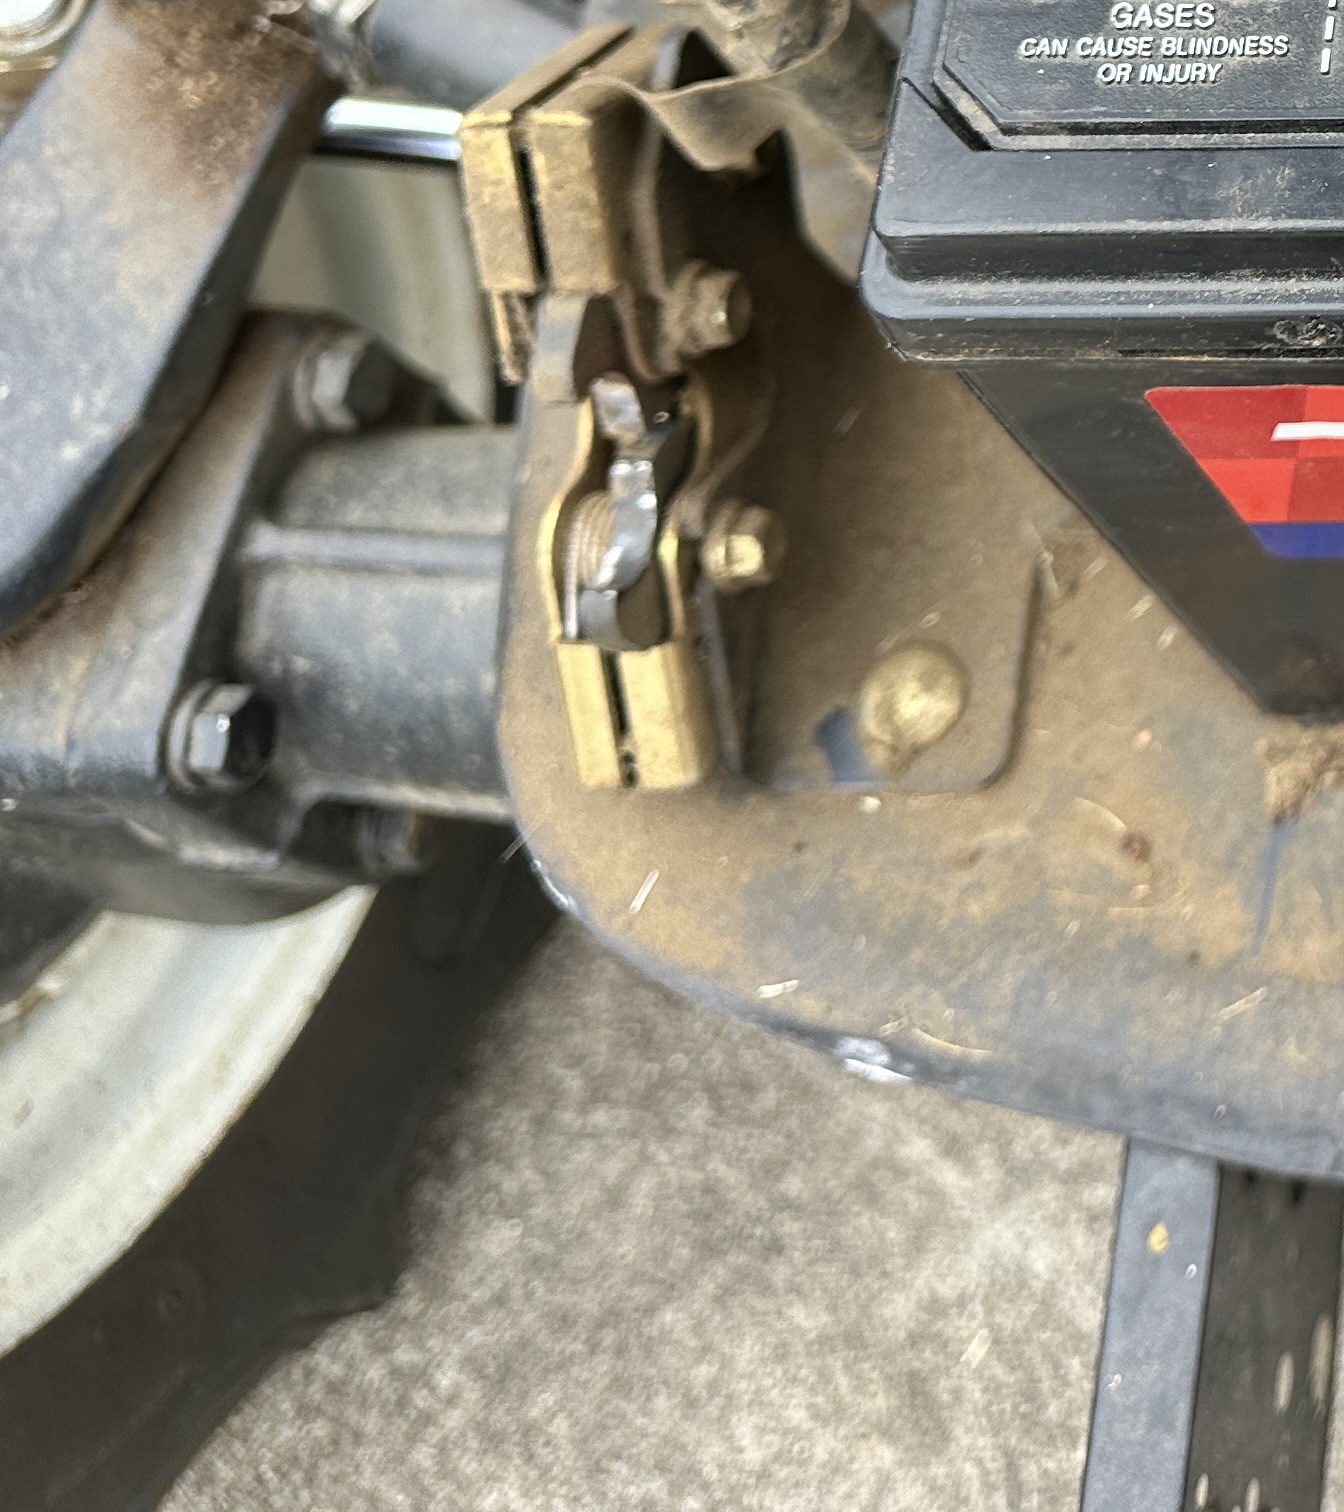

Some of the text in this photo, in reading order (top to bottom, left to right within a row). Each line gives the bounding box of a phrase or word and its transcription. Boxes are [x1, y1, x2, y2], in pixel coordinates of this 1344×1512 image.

[1110, 2, 1216, 29] GASES
[1019, 35, 1290, 58] CAN CAUSE BLINDNESS
[1098, 63, 1223, 83] OR INJURY
